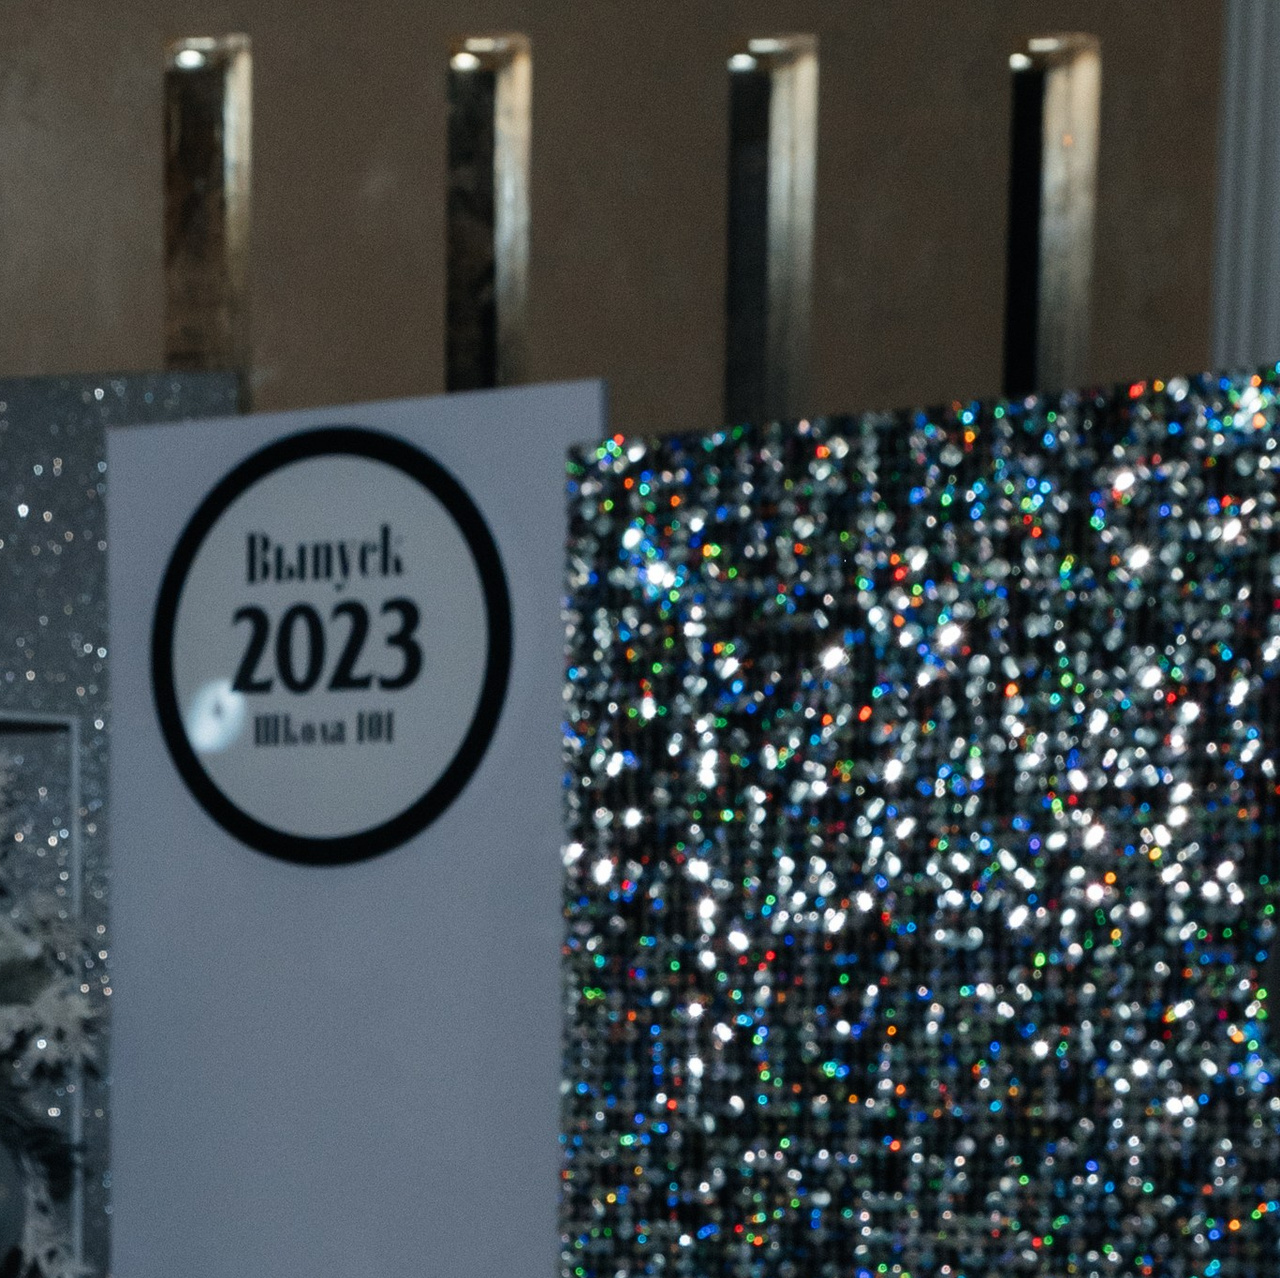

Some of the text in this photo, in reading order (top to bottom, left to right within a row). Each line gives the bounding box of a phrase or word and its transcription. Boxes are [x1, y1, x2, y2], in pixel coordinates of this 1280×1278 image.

[245, 523, 404, 592] Выпуск
[230, 598, 424, 695] 2023
[253, 712, 347, 747] Школа
